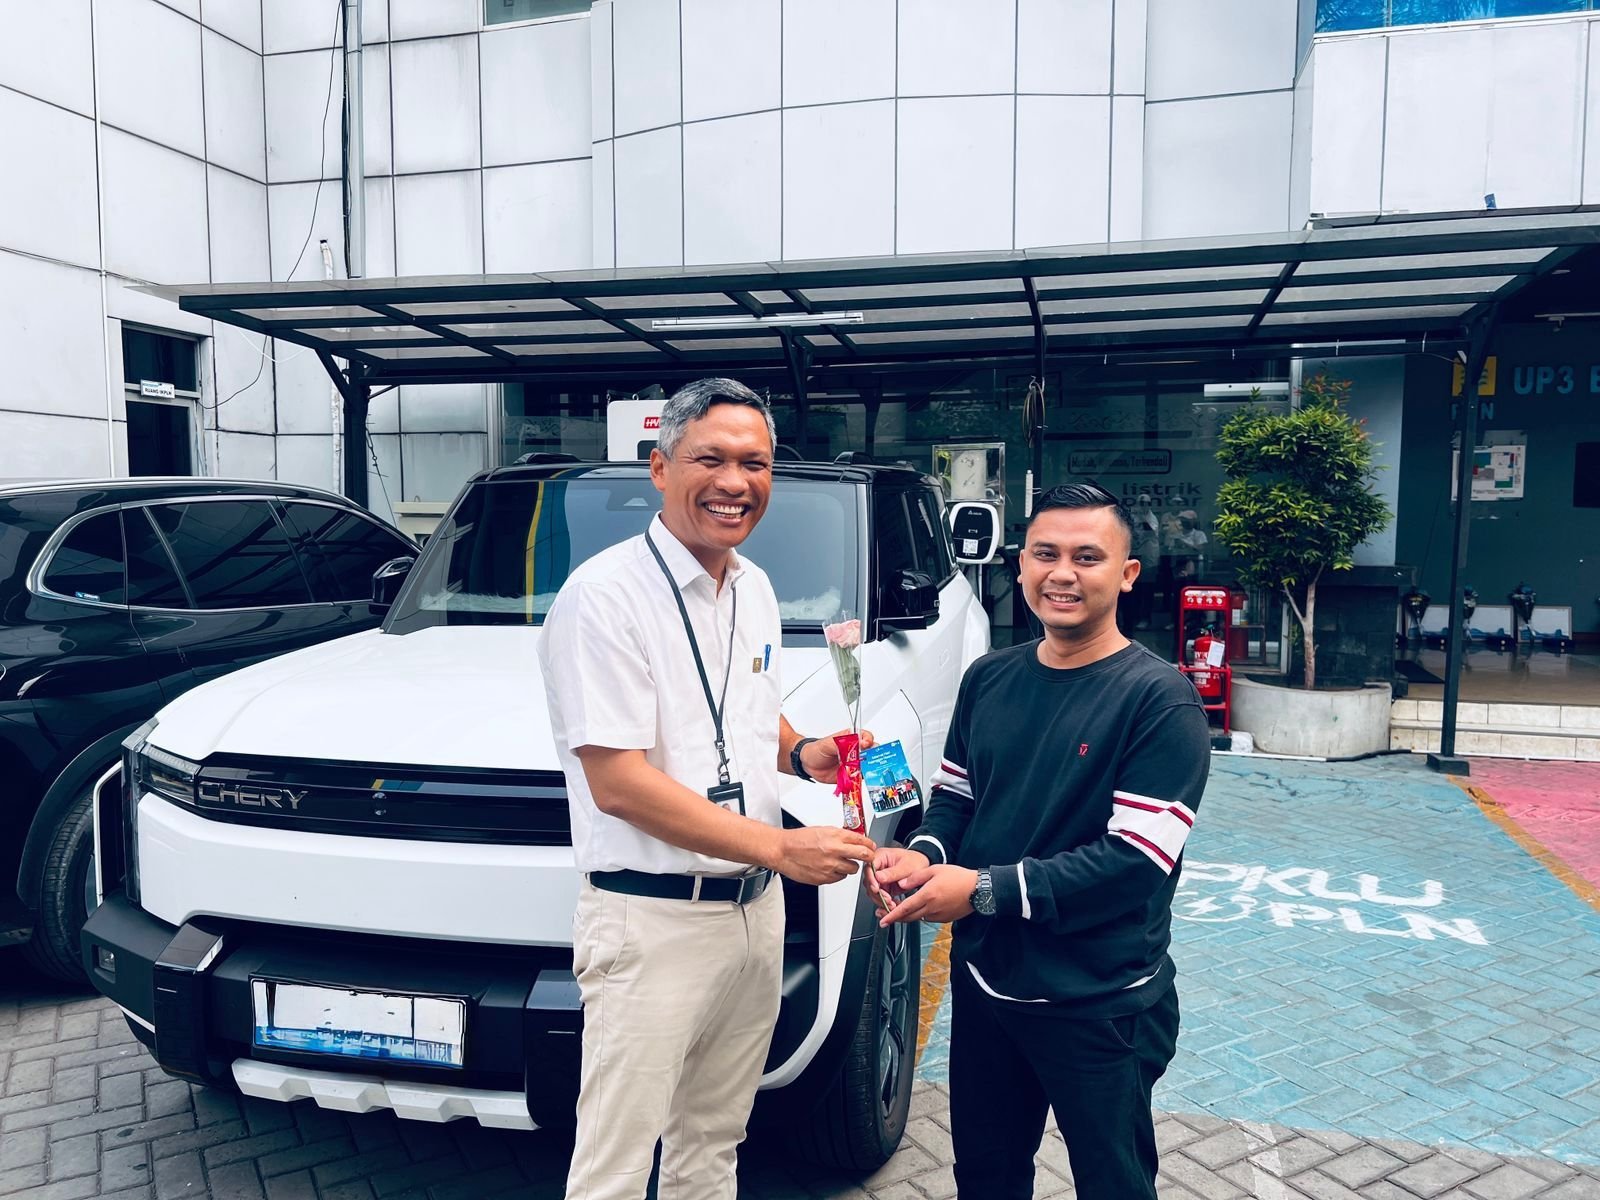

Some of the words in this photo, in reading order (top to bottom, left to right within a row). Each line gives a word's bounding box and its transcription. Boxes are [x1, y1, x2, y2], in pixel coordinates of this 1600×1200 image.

[1513, 365, 1574, 395] UP3
[1122, 482, 1202, 496] listrik
[198, 781, 308, 809] CHERY
[1175, 860, 1443, 907] PKLU
[1267, 900, 1490, 946] PLN
